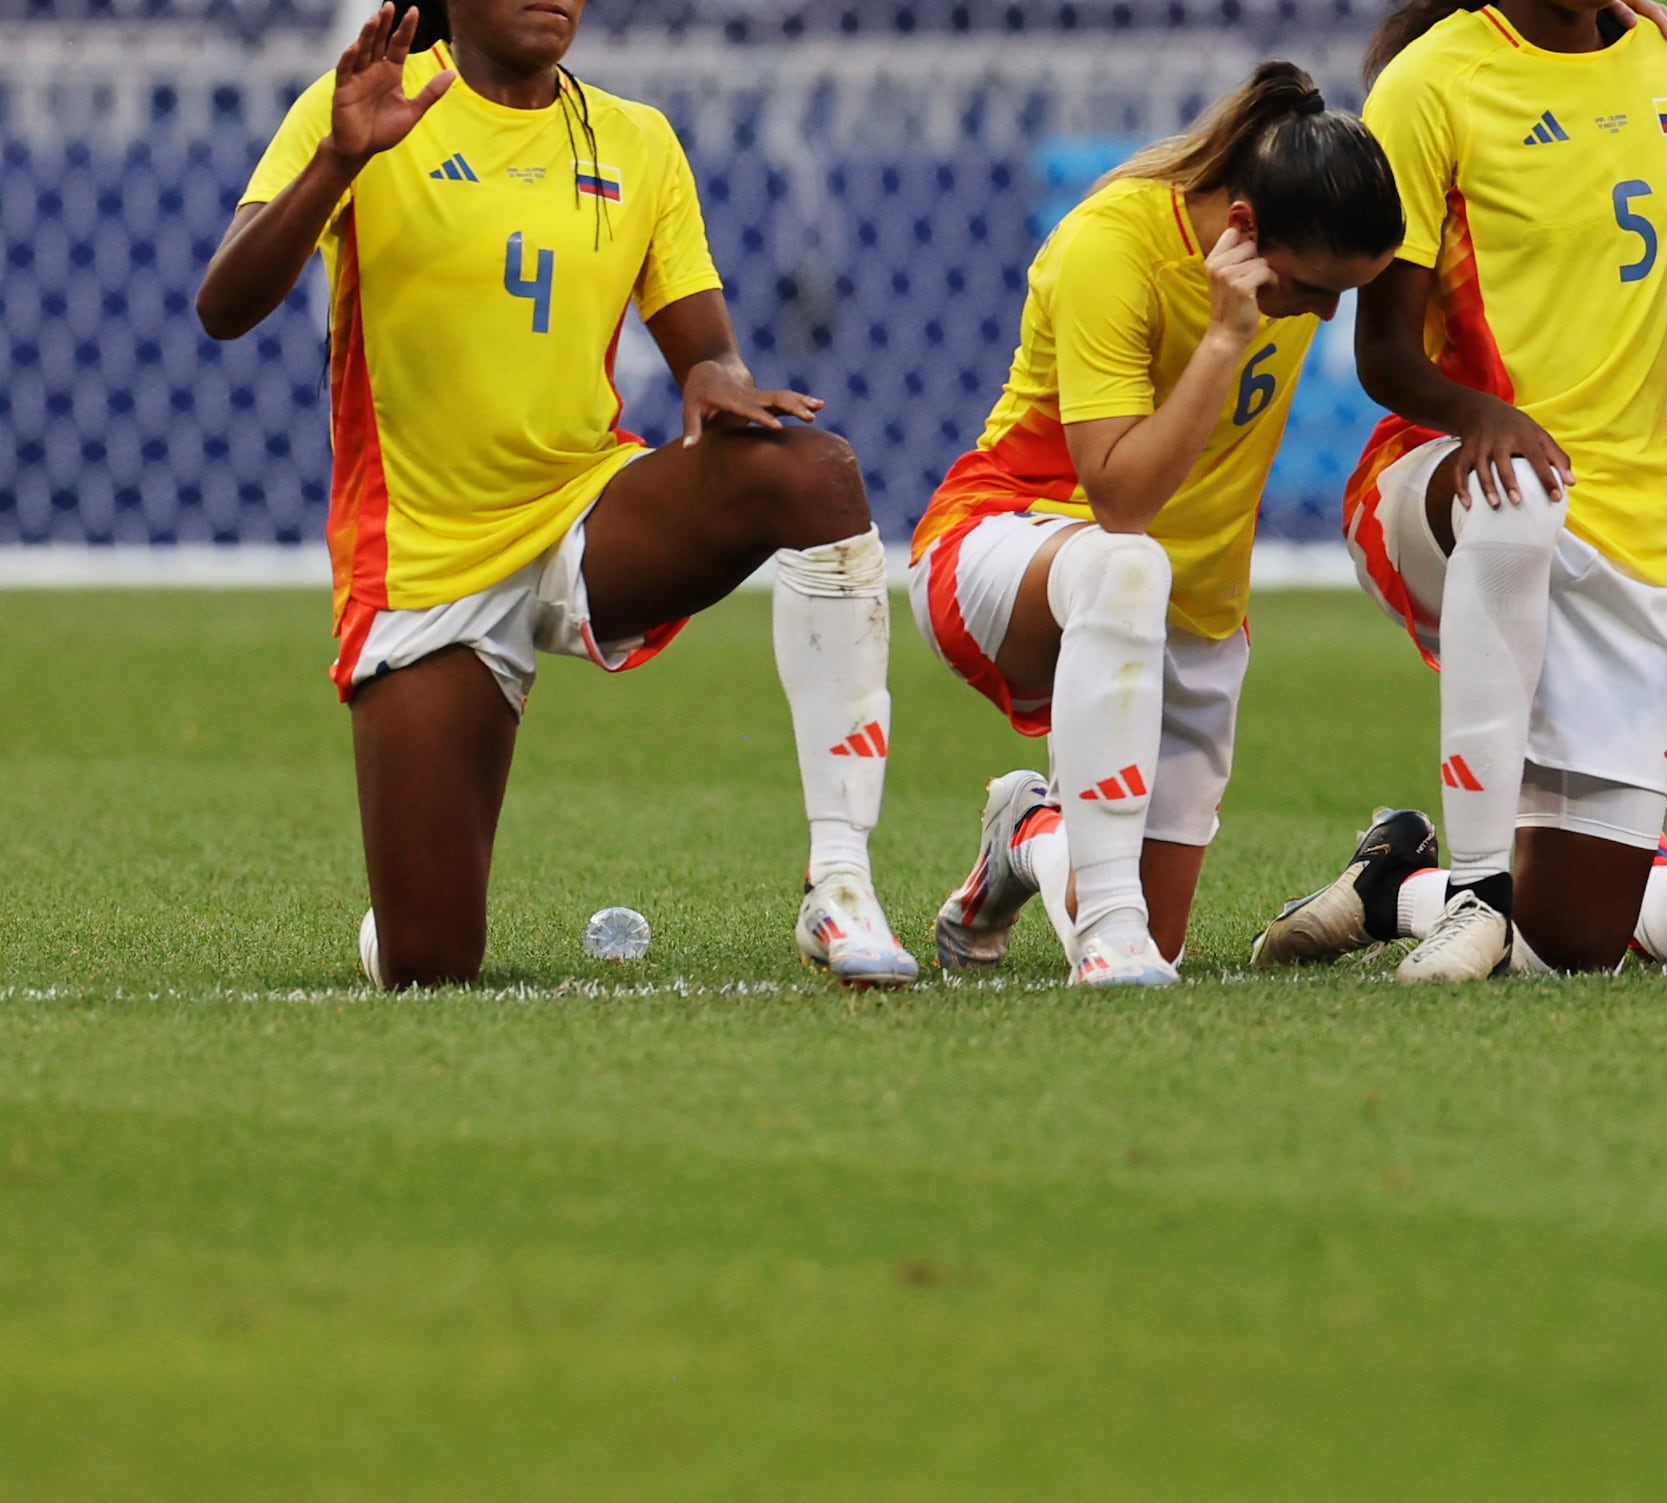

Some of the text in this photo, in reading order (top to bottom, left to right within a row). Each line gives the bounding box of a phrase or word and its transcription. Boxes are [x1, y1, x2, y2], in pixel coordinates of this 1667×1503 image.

[504, 231, 554, 333] 4
[1612, 180, 1658, 282] 5
[1234, 342, 1278, 427] 6
